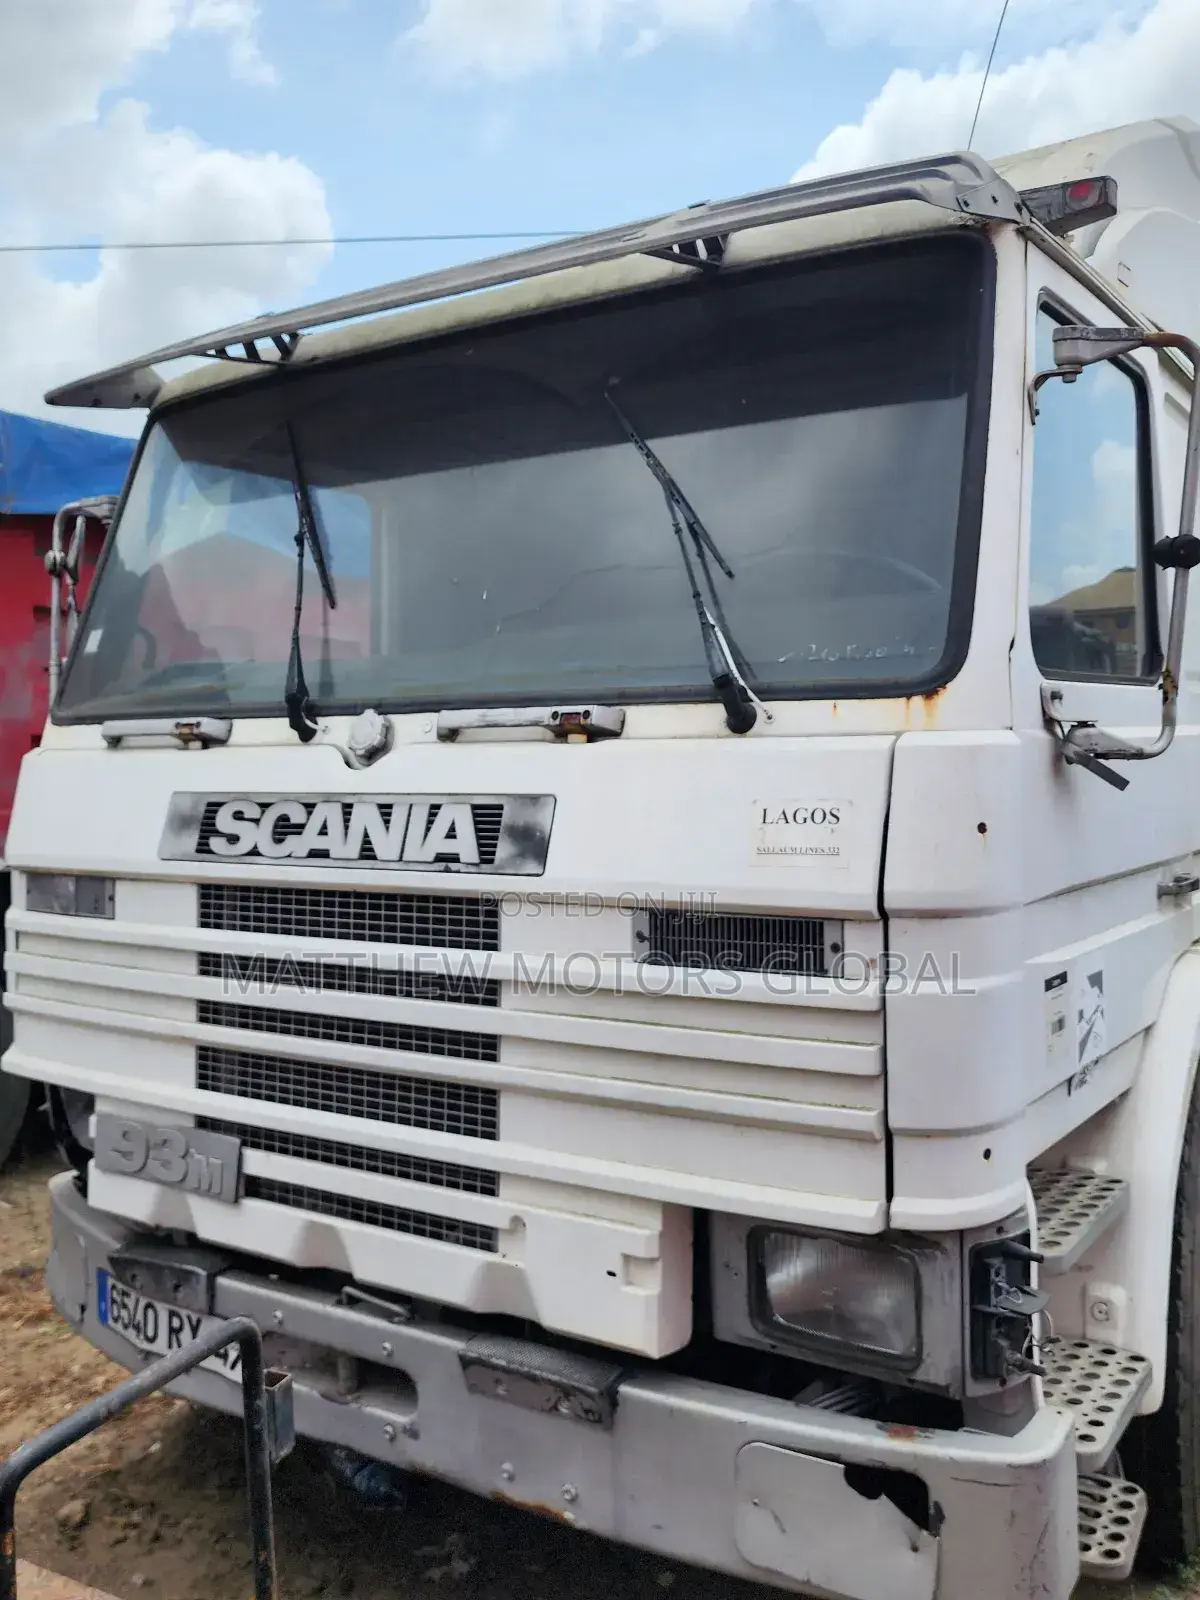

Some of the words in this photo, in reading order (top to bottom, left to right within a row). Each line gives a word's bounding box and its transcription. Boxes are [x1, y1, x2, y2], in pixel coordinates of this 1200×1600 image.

[209, 799, 480, 864] SCANIA
[761, 807, 841, 825] LAGOS
[109, 1283, 159, 1344] 6540
